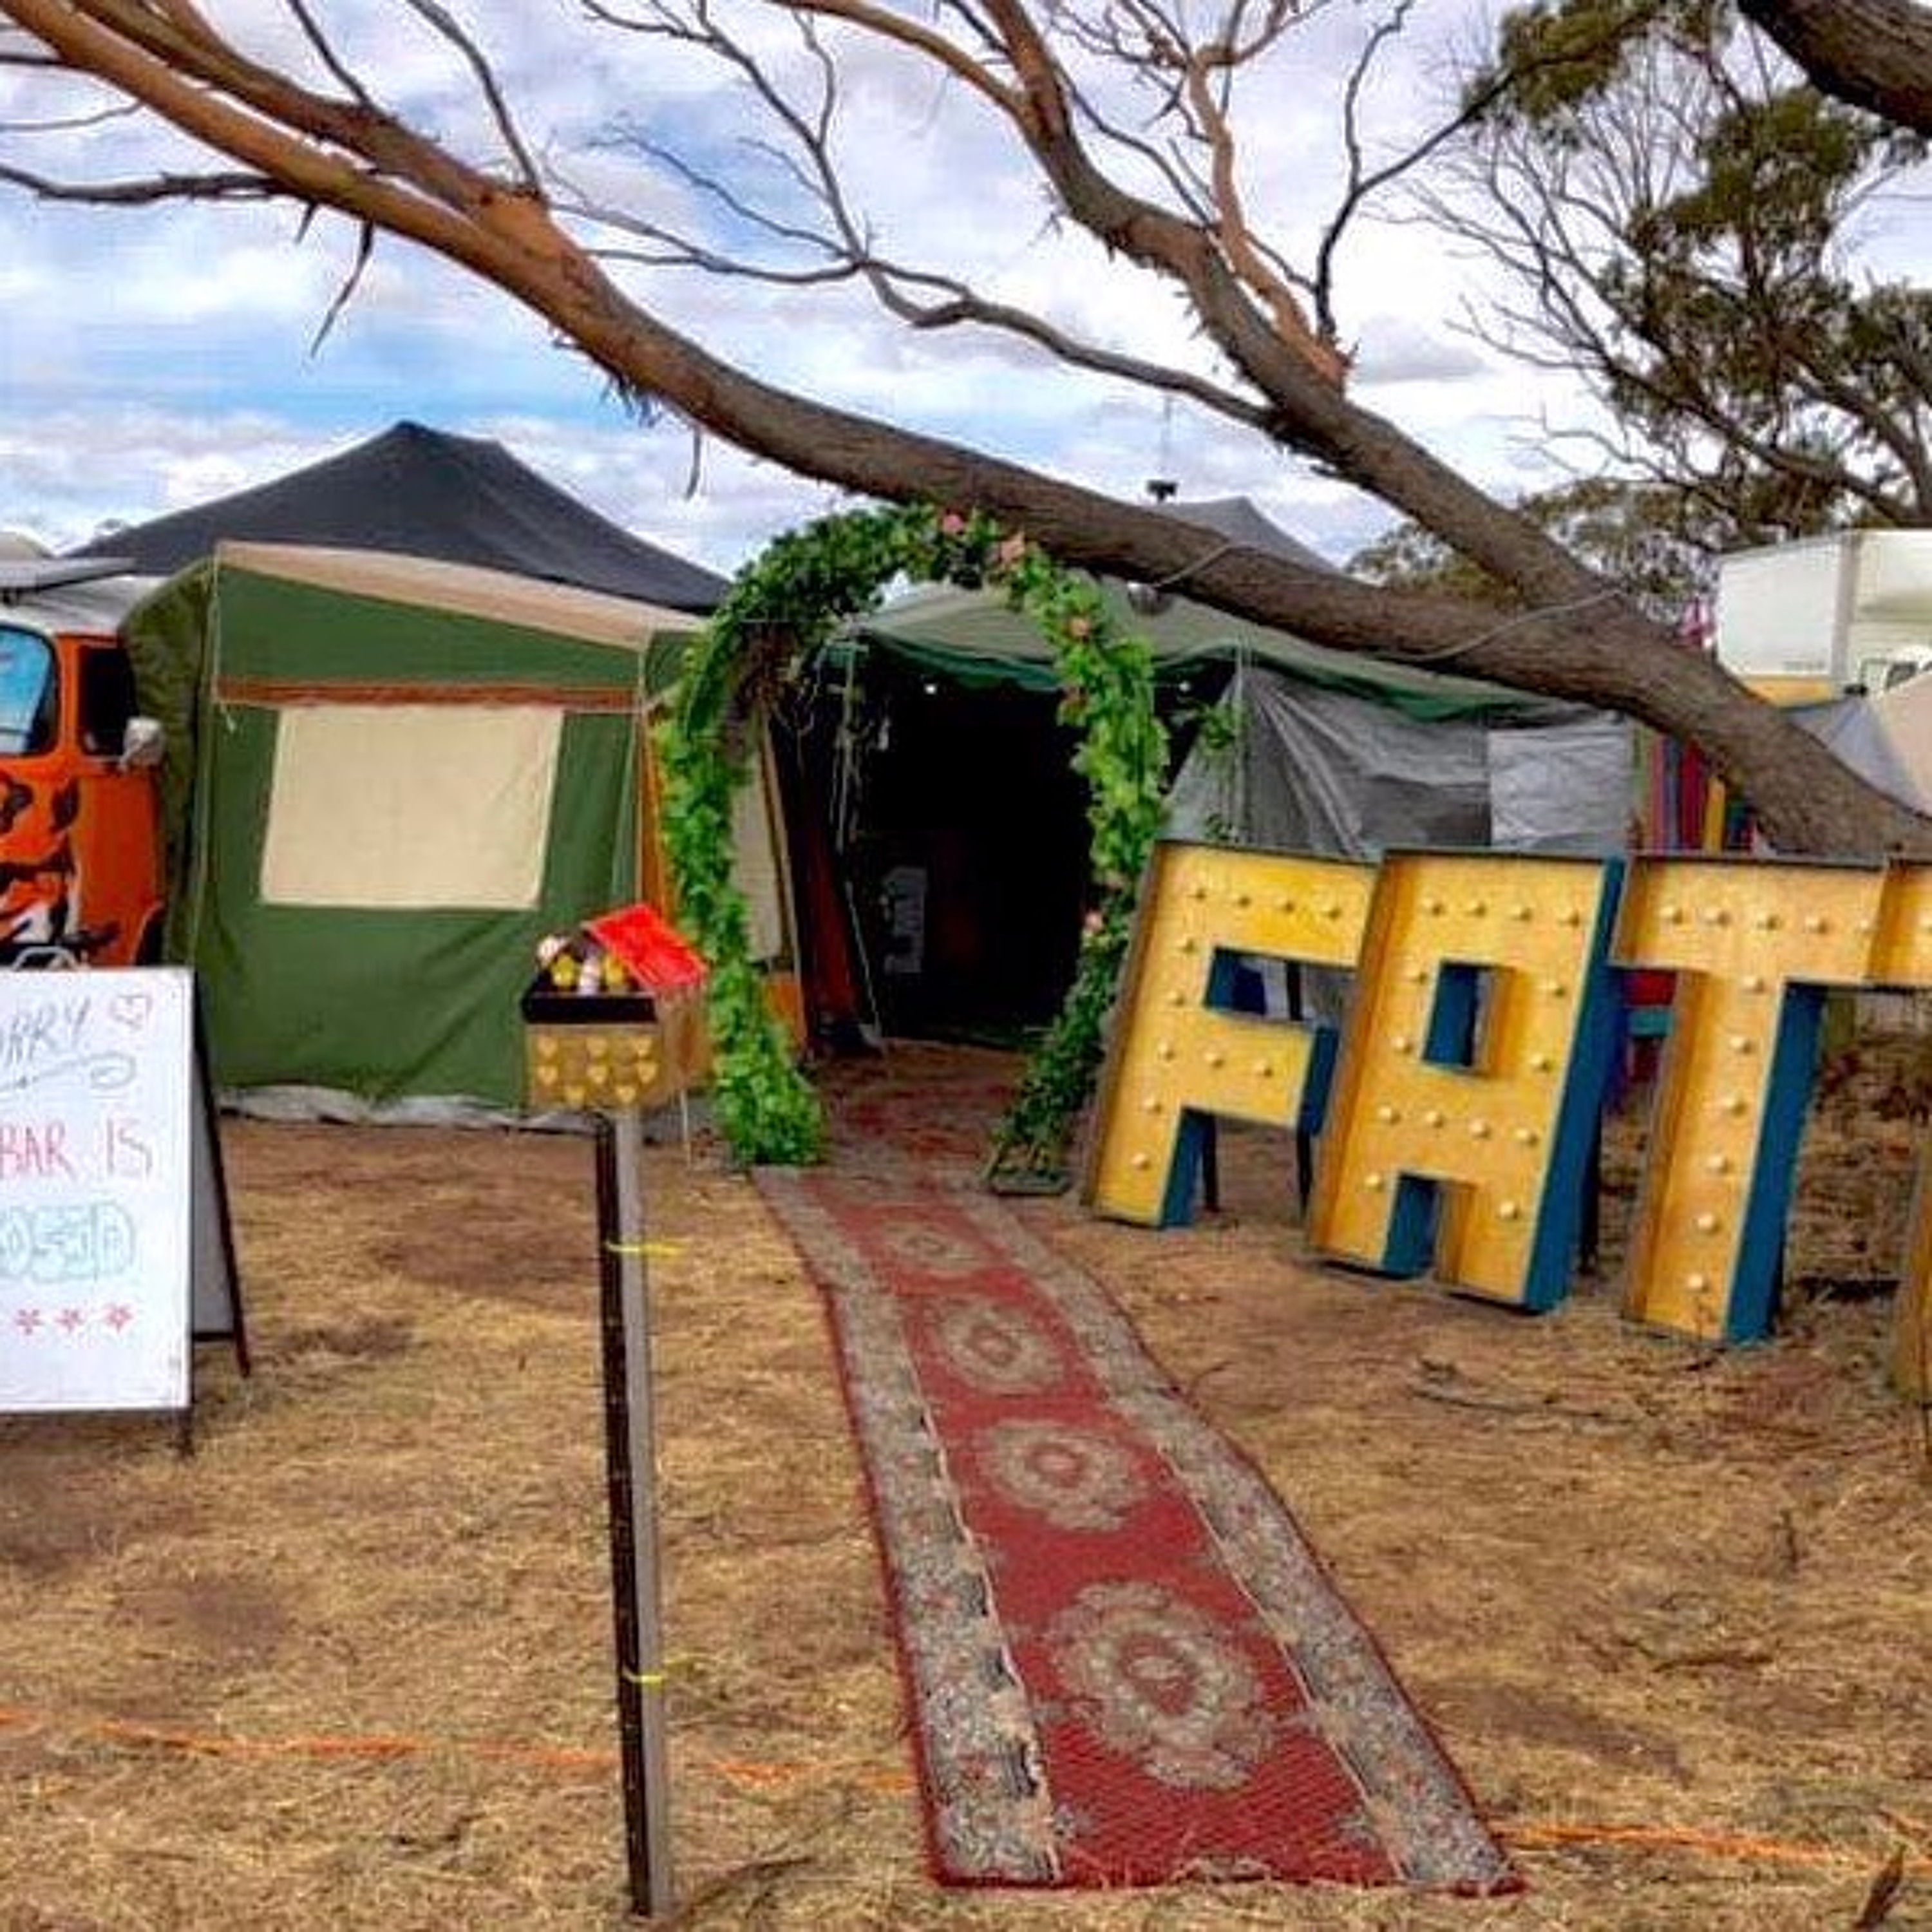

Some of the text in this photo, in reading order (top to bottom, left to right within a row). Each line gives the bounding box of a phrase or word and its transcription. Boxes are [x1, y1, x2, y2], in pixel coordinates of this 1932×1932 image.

[0, 1116, 153, 1184] BAR IS
[1082, 839, 1932, 1410] FAT
